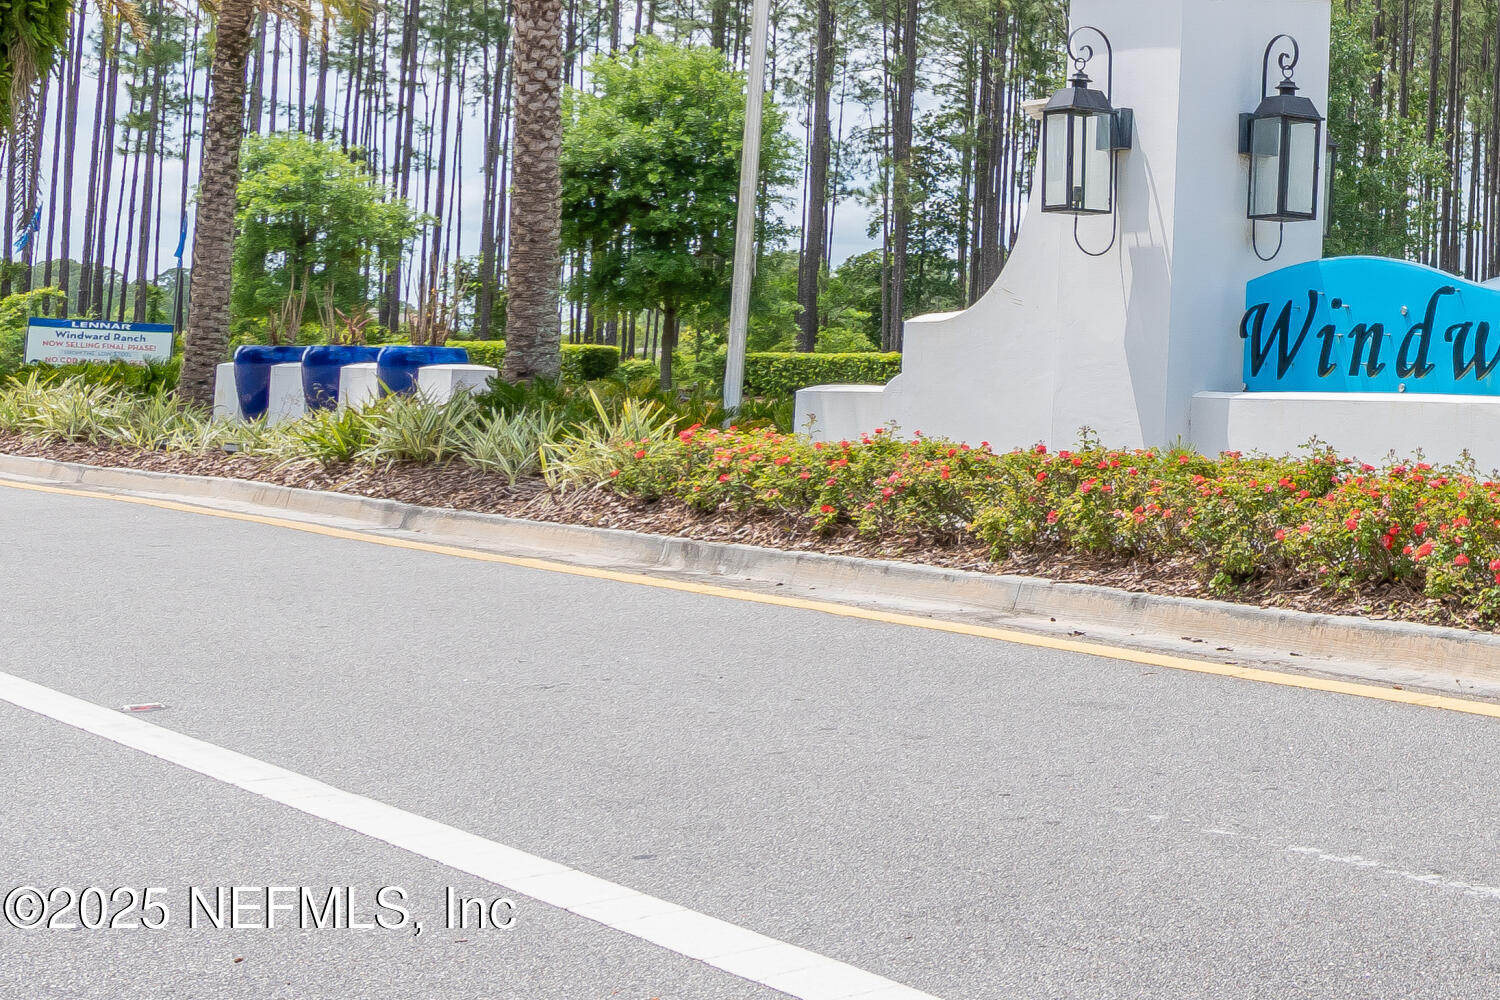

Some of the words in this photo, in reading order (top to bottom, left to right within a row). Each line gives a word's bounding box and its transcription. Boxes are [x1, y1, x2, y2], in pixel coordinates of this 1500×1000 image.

[71, 321, 132, 331] LENNAR
[55, 330, 110, 341] Windward
[113, 333, 146, 343] Ranch
[65, 341, 100, 349] SELLING
[102, 343, 125, 351] FINAL
[127, 344, 157, 352] PHASE!
